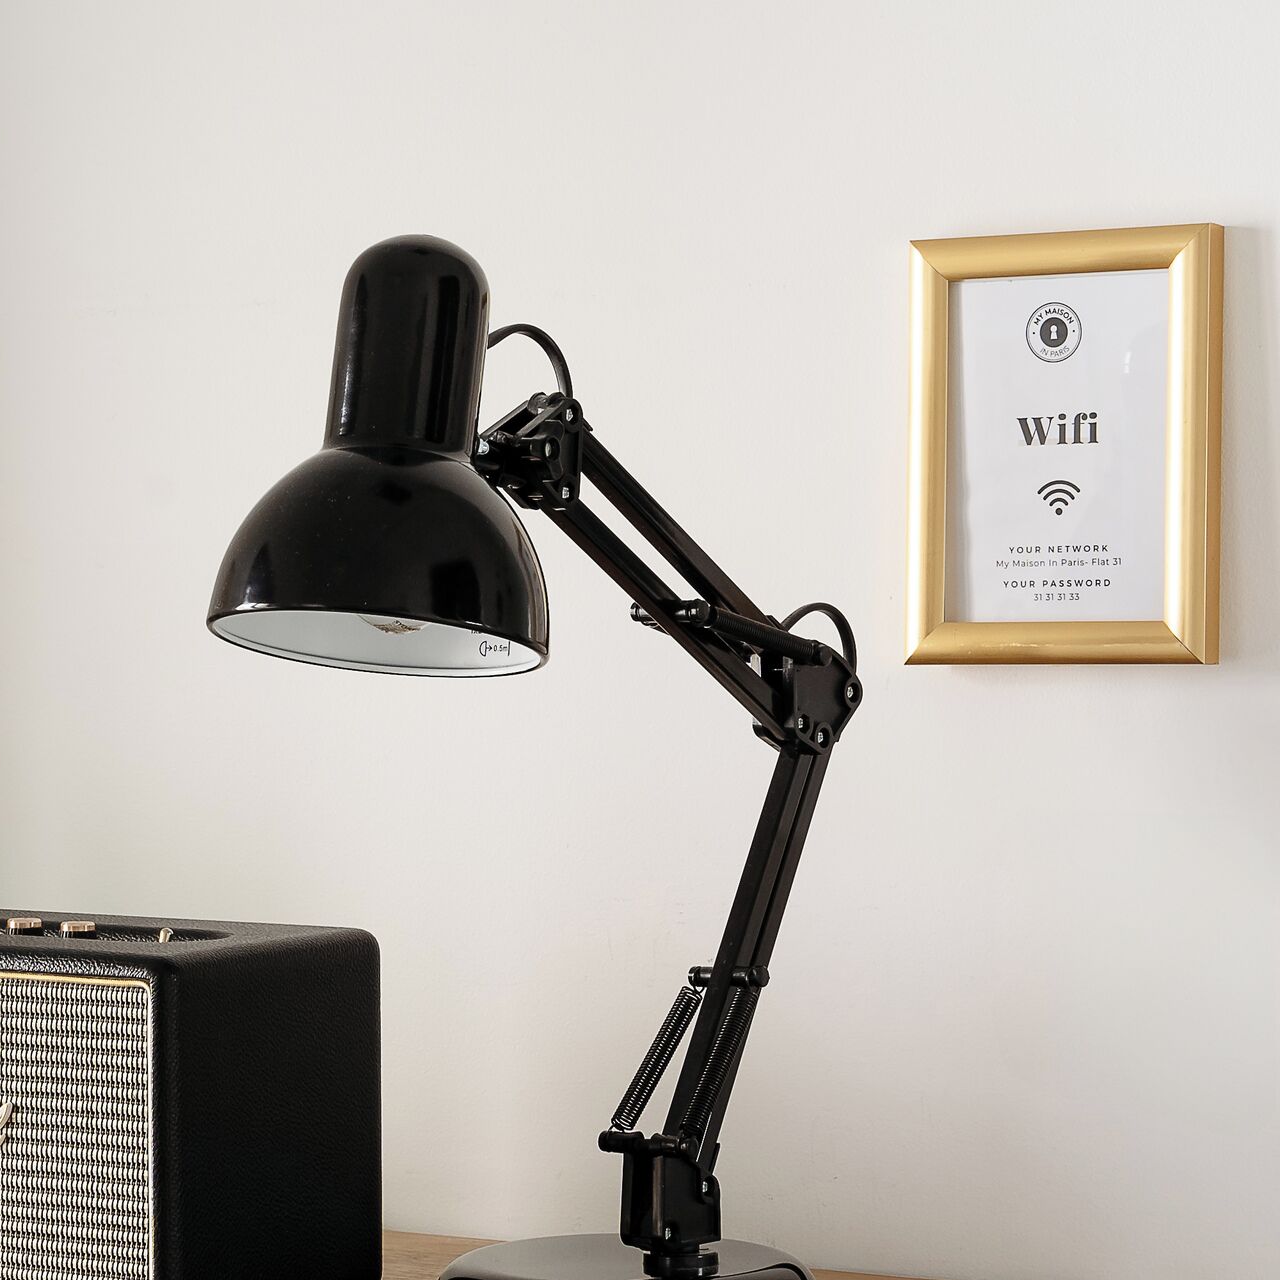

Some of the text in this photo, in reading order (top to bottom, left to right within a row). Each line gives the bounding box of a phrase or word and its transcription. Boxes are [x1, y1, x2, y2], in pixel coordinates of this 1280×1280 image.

[1033, 307, 1075, 326] MY MAISON
[1040, 345, 1070, 358] IN PARIS
[1016, 412, 1099, 446] Wifi
[1008, 545, 1109, 554] YOUR NETWORK
[996, 560, 1010, 569] My
[1012, 559, 1046, 567] Maison
[1048, 559, 1058, 567] In
[1091, 558, 1110, 566] Flat
[1112, 557, 1122, 566] 31
[1003, 579, 1111, 588] YOUR PASSWORD
[1033, 592, 1080, 601] 31 31 31 33
[493, 644, 508, 652] 0.5m
